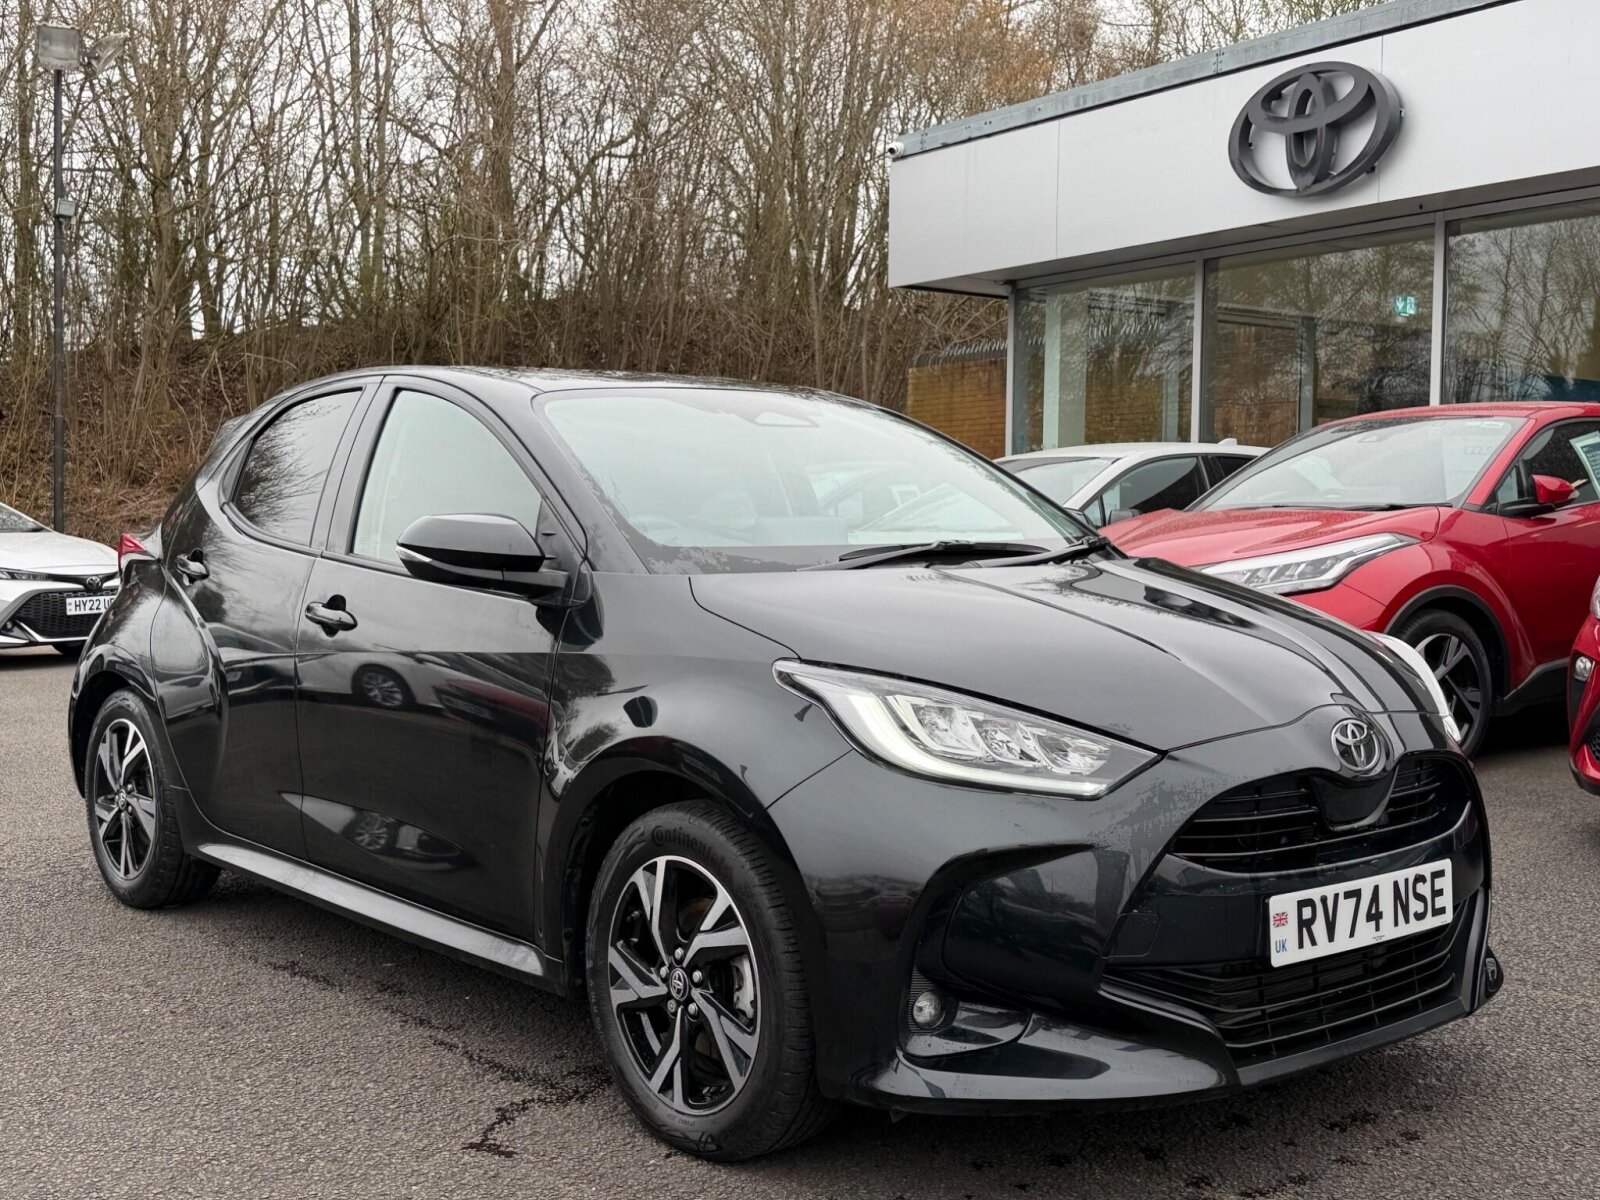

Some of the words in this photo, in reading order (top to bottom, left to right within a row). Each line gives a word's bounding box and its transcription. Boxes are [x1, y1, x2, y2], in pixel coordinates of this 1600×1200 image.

[74, 599, 101, 612] HY22
[1296, 884, 1384, 950] RV74
[1392, 868, 1447, 928] NSE
[1274, 938, 1288, 954] UK
